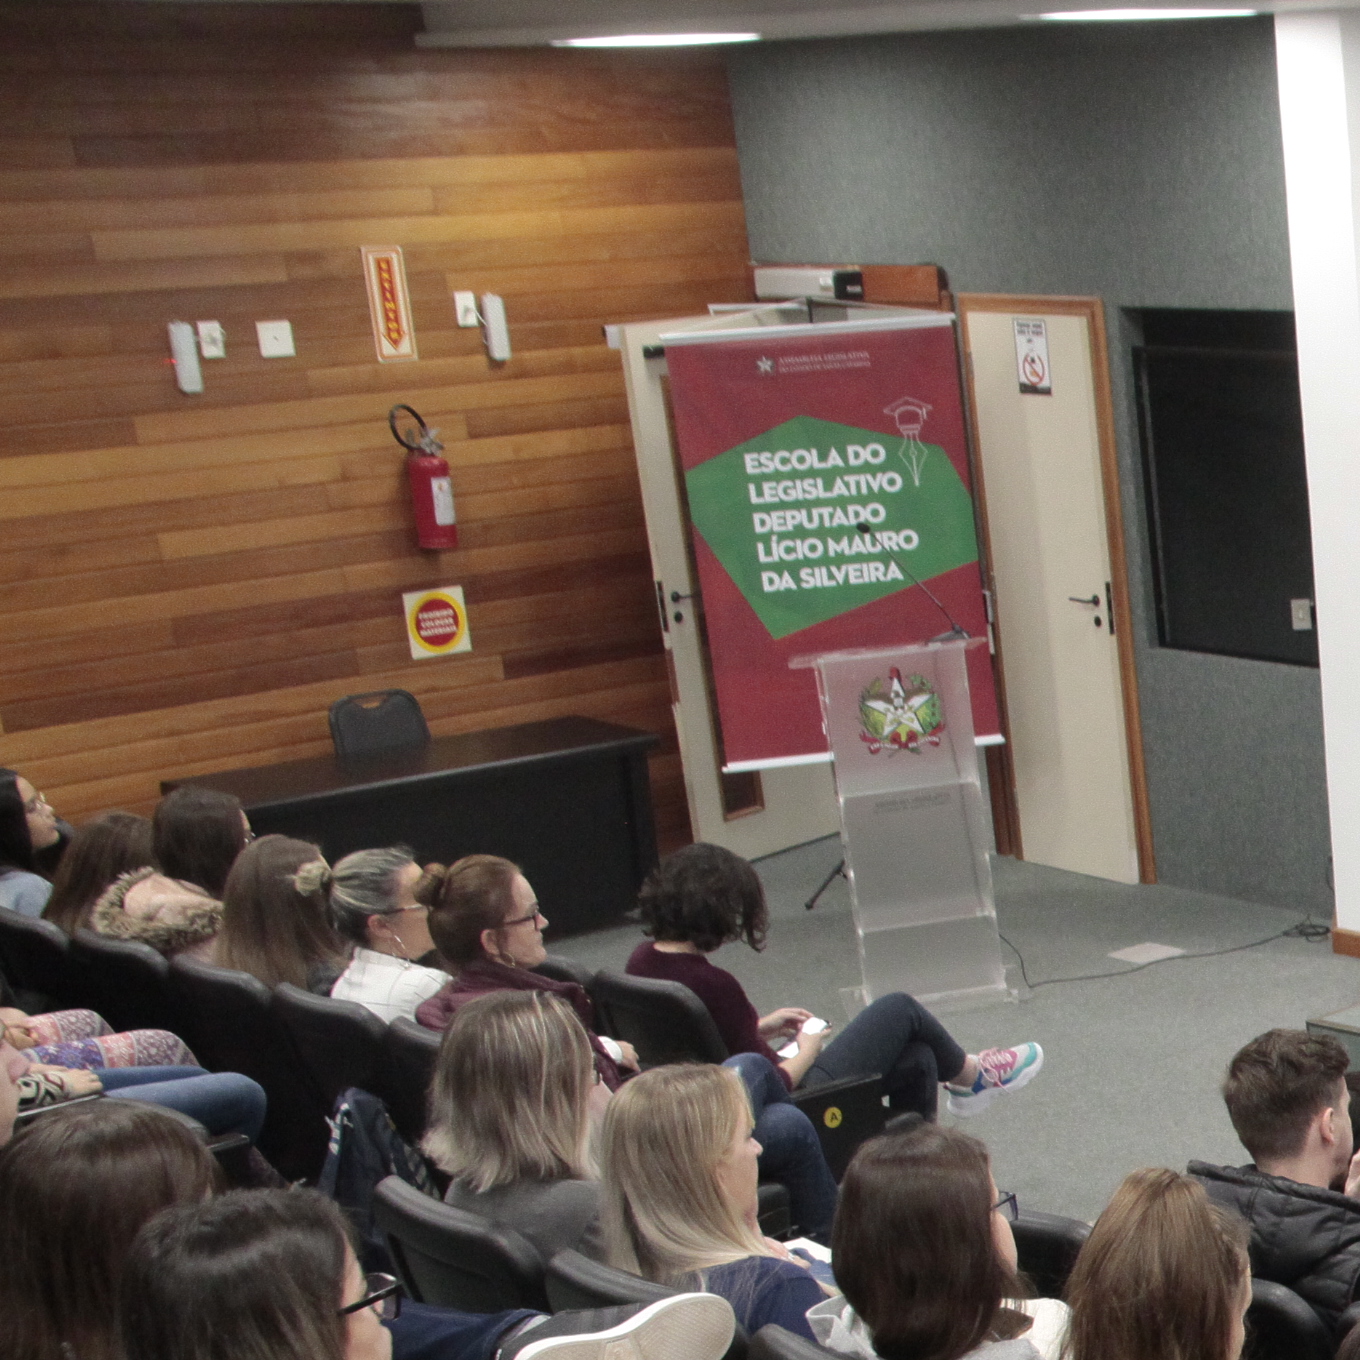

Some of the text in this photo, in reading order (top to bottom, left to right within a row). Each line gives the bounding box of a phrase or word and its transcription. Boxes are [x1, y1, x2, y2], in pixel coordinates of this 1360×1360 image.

[743, 443, 886, 475] ESCOLA DO
[748, 471, 903, 504] LEGISLATIVO
[752, 502, 886, 534] DEPUTADO
[757, 529, 919, 563] LÍCIO MAURO
[761, 560, 904, 592] DA SILVEIRA
